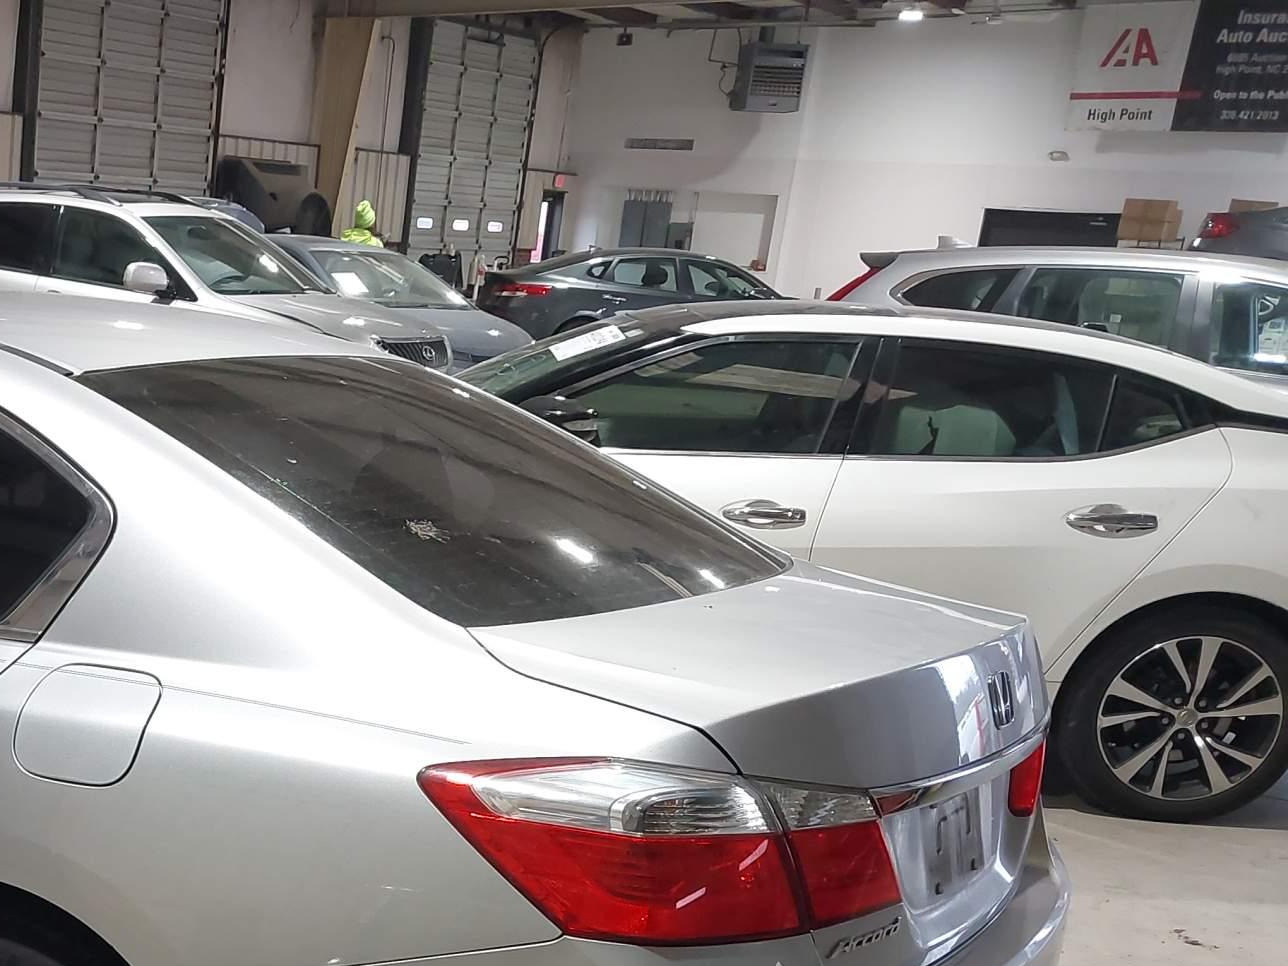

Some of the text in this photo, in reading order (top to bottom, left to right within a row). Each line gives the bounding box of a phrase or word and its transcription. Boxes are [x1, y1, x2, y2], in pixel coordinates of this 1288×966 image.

[1237, 9, 1288, 25] Insura
[1216, 28, 1253, 43] Auto
[1100, 27, 1159, 67] IAA
[1213, 89, 1237, 101] Open
[1238, 91, 1249, 99] to
[1250, 90, 1265, 100] the
[1087, 108, 1152, 123] High Point
[825, 916, 902, 959] Accord
